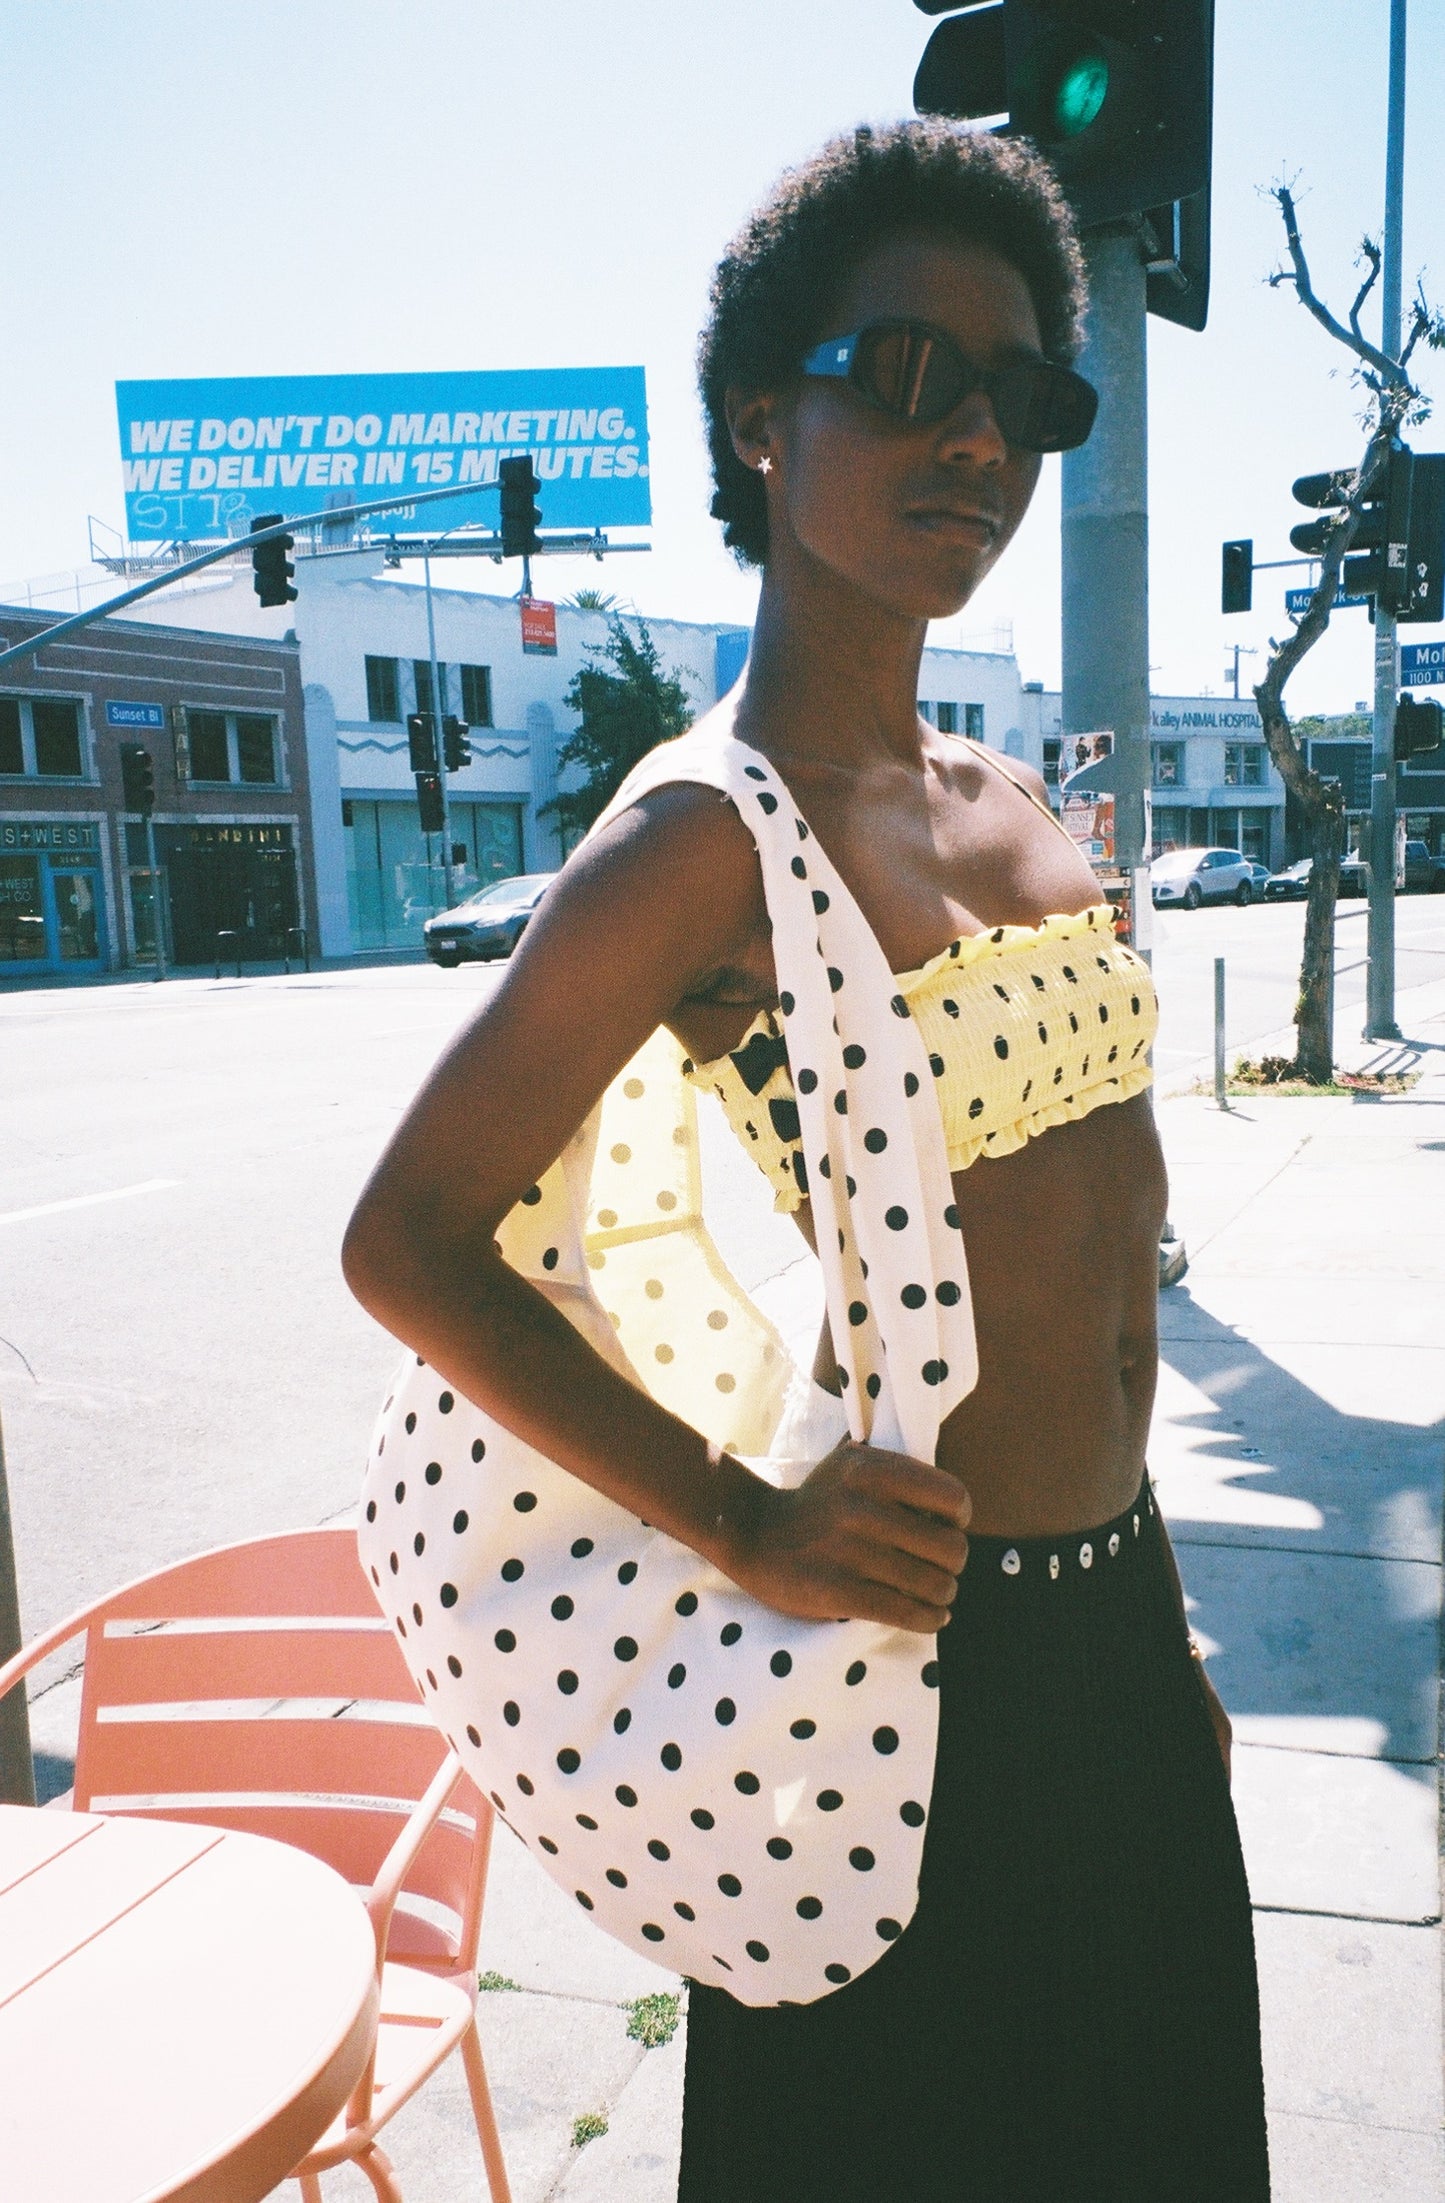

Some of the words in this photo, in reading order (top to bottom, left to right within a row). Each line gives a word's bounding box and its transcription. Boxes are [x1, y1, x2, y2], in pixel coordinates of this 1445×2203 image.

[130, 419, 195, 454] WE
[198, 415, 323, 451] DON'T
[324, 413, 383, 447] DO
[387, 407, 636, 446] MARKETING.
[122, 456, 184, 493] WE
[188, 453, 360, 489] DELIVER
[362, 450, 406, 485] IN
[411, 450, 454, 484] 15
[1410, 672, 1431, 684] 1100
[1436, 671, 1444, 682] N
[111, 706, 146, 721] Sunset
[148, 709, 159, 722] Bl
[1181, 712, 1218, 728] ANIMAL
[1218, 713, 1261, 729] HOSPITAL
